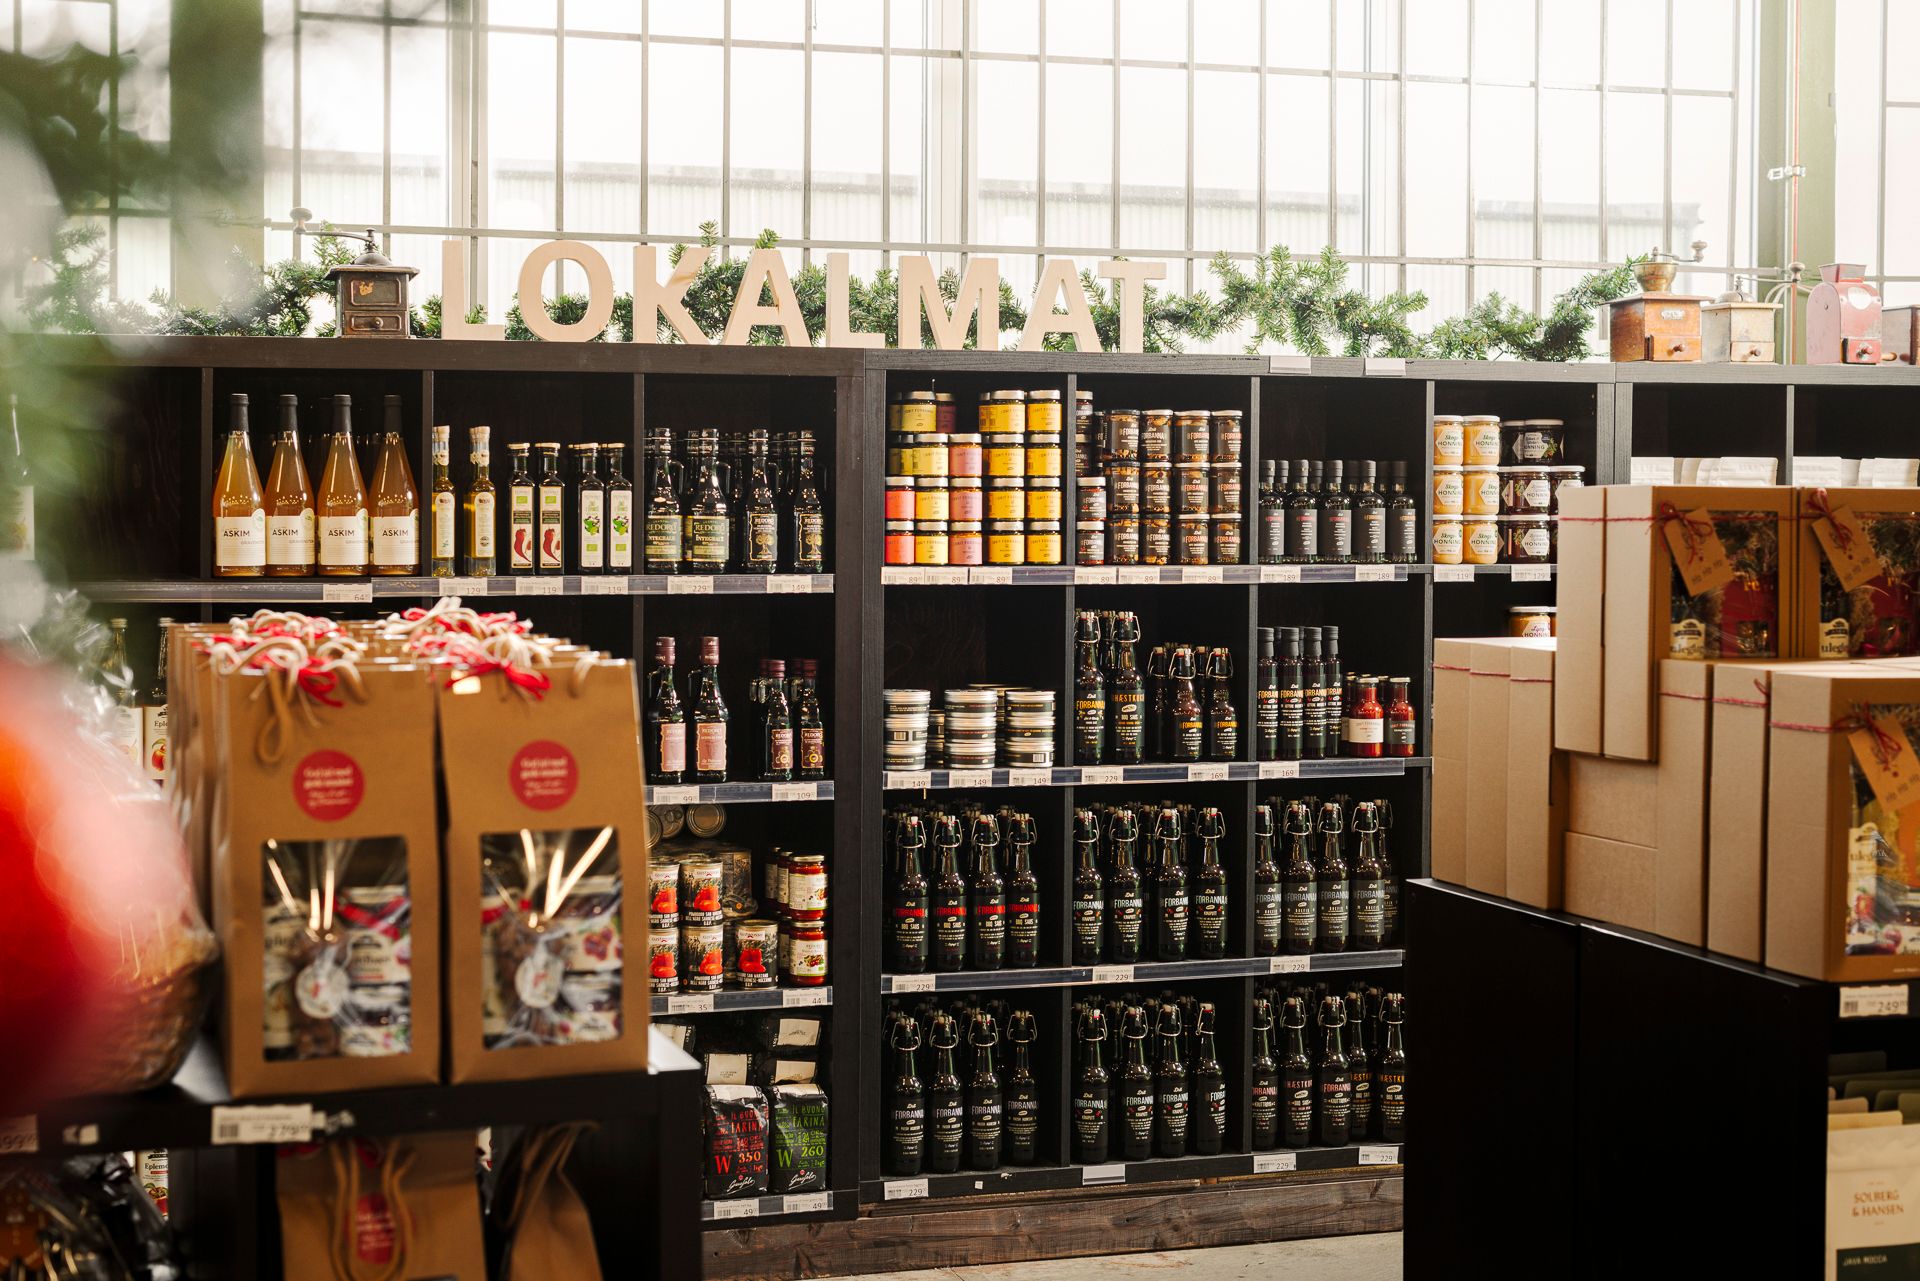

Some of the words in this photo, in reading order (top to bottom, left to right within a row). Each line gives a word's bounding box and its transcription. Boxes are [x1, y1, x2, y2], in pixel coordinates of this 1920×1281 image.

[441, 239, 1168, 353] LOKALMAT
[382, 529, 408, 537] ASKIM
[1282, 769, 1295, 777] 169
[1105, 775, 1118, 783] 229
[1292, 963, 1305, 971] 229
[1877, 1000, 1900, 1013] 249
[776, 1148, 794, 1168] W
[801, 1145, 825, 1158] 260
[714, 1154, 733, 1175] W
[738, 1151, 761, 1164] 350
[909, 1188, 923, 1196] 229
